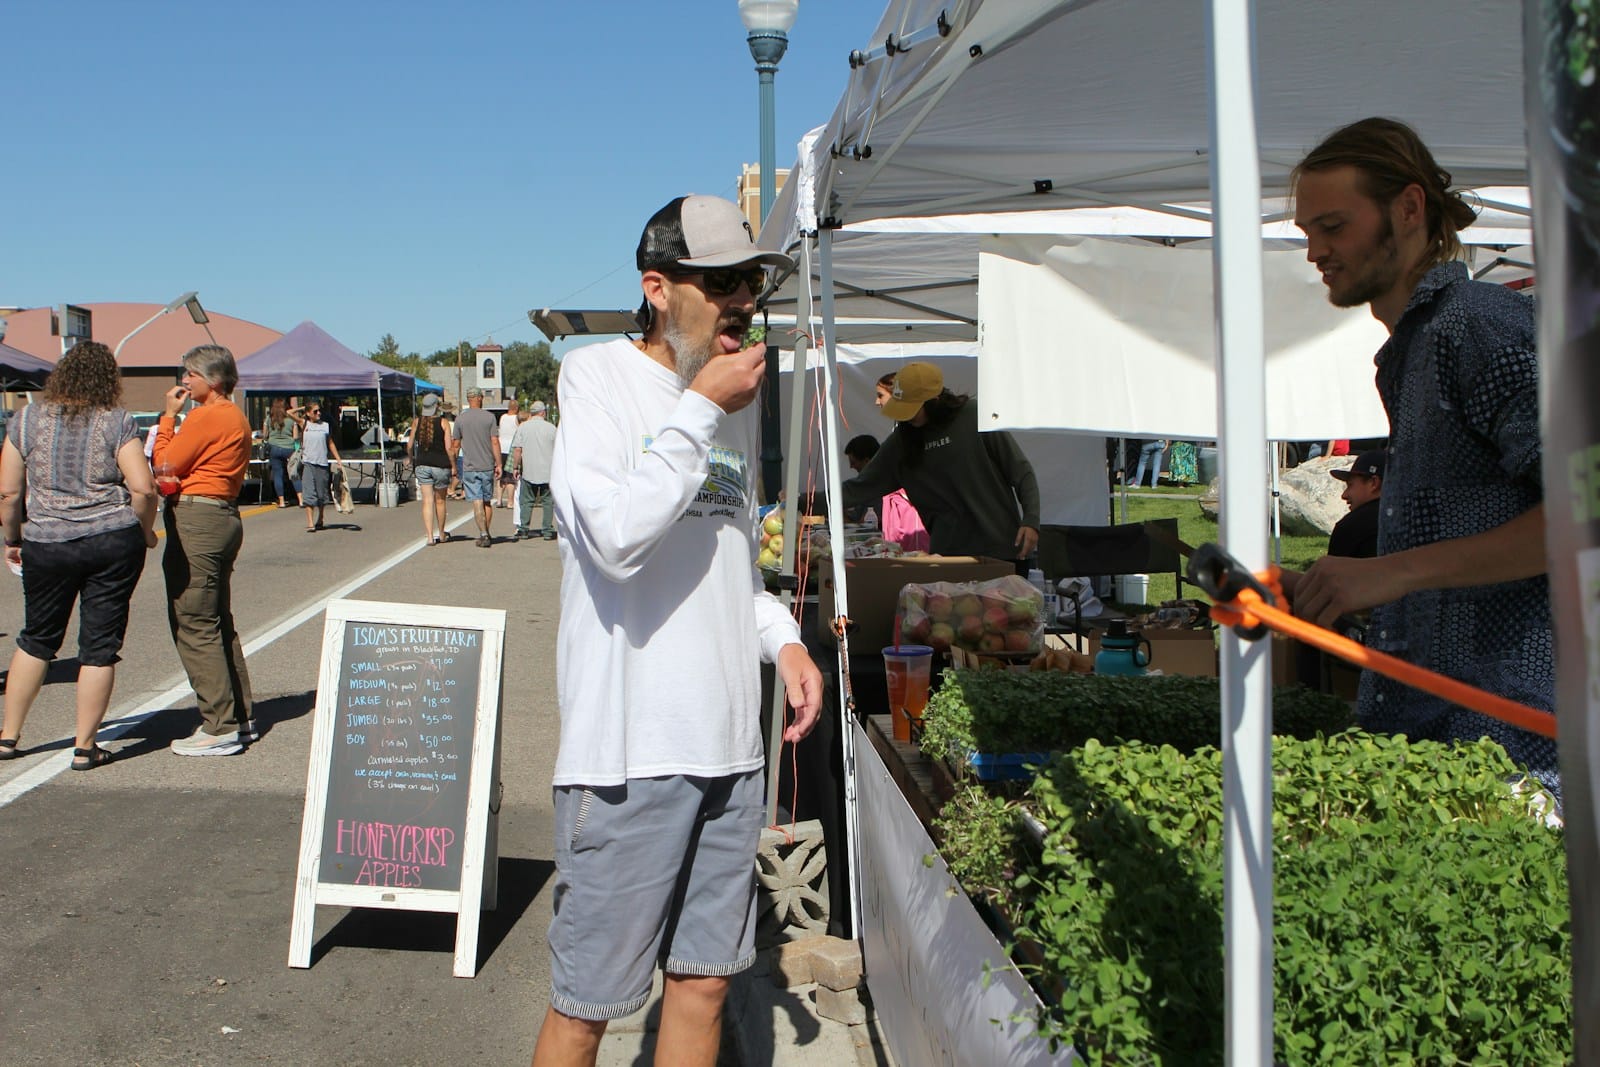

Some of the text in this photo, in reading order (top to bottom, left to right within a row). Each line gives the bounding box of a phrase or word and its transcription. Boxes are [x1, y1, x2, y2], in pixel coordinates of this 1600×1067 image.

[353, 627, 477, 648] ISOM'S FRUIT FARM
[351, 662, 381, 674] SMALL
[349, 679, 387, 689] MEDIUM
[348, 695, 382, 708] LARGE
[346, 713, 378, 727] JUMBO
[346, 734, 365, 745] BOX
[354, 768, 367, 776] we
[368, 768, 393, 780] accept
[335, 819, 455, 867] HONEYCRISP
[355, 859, 422, 888] APPLES
